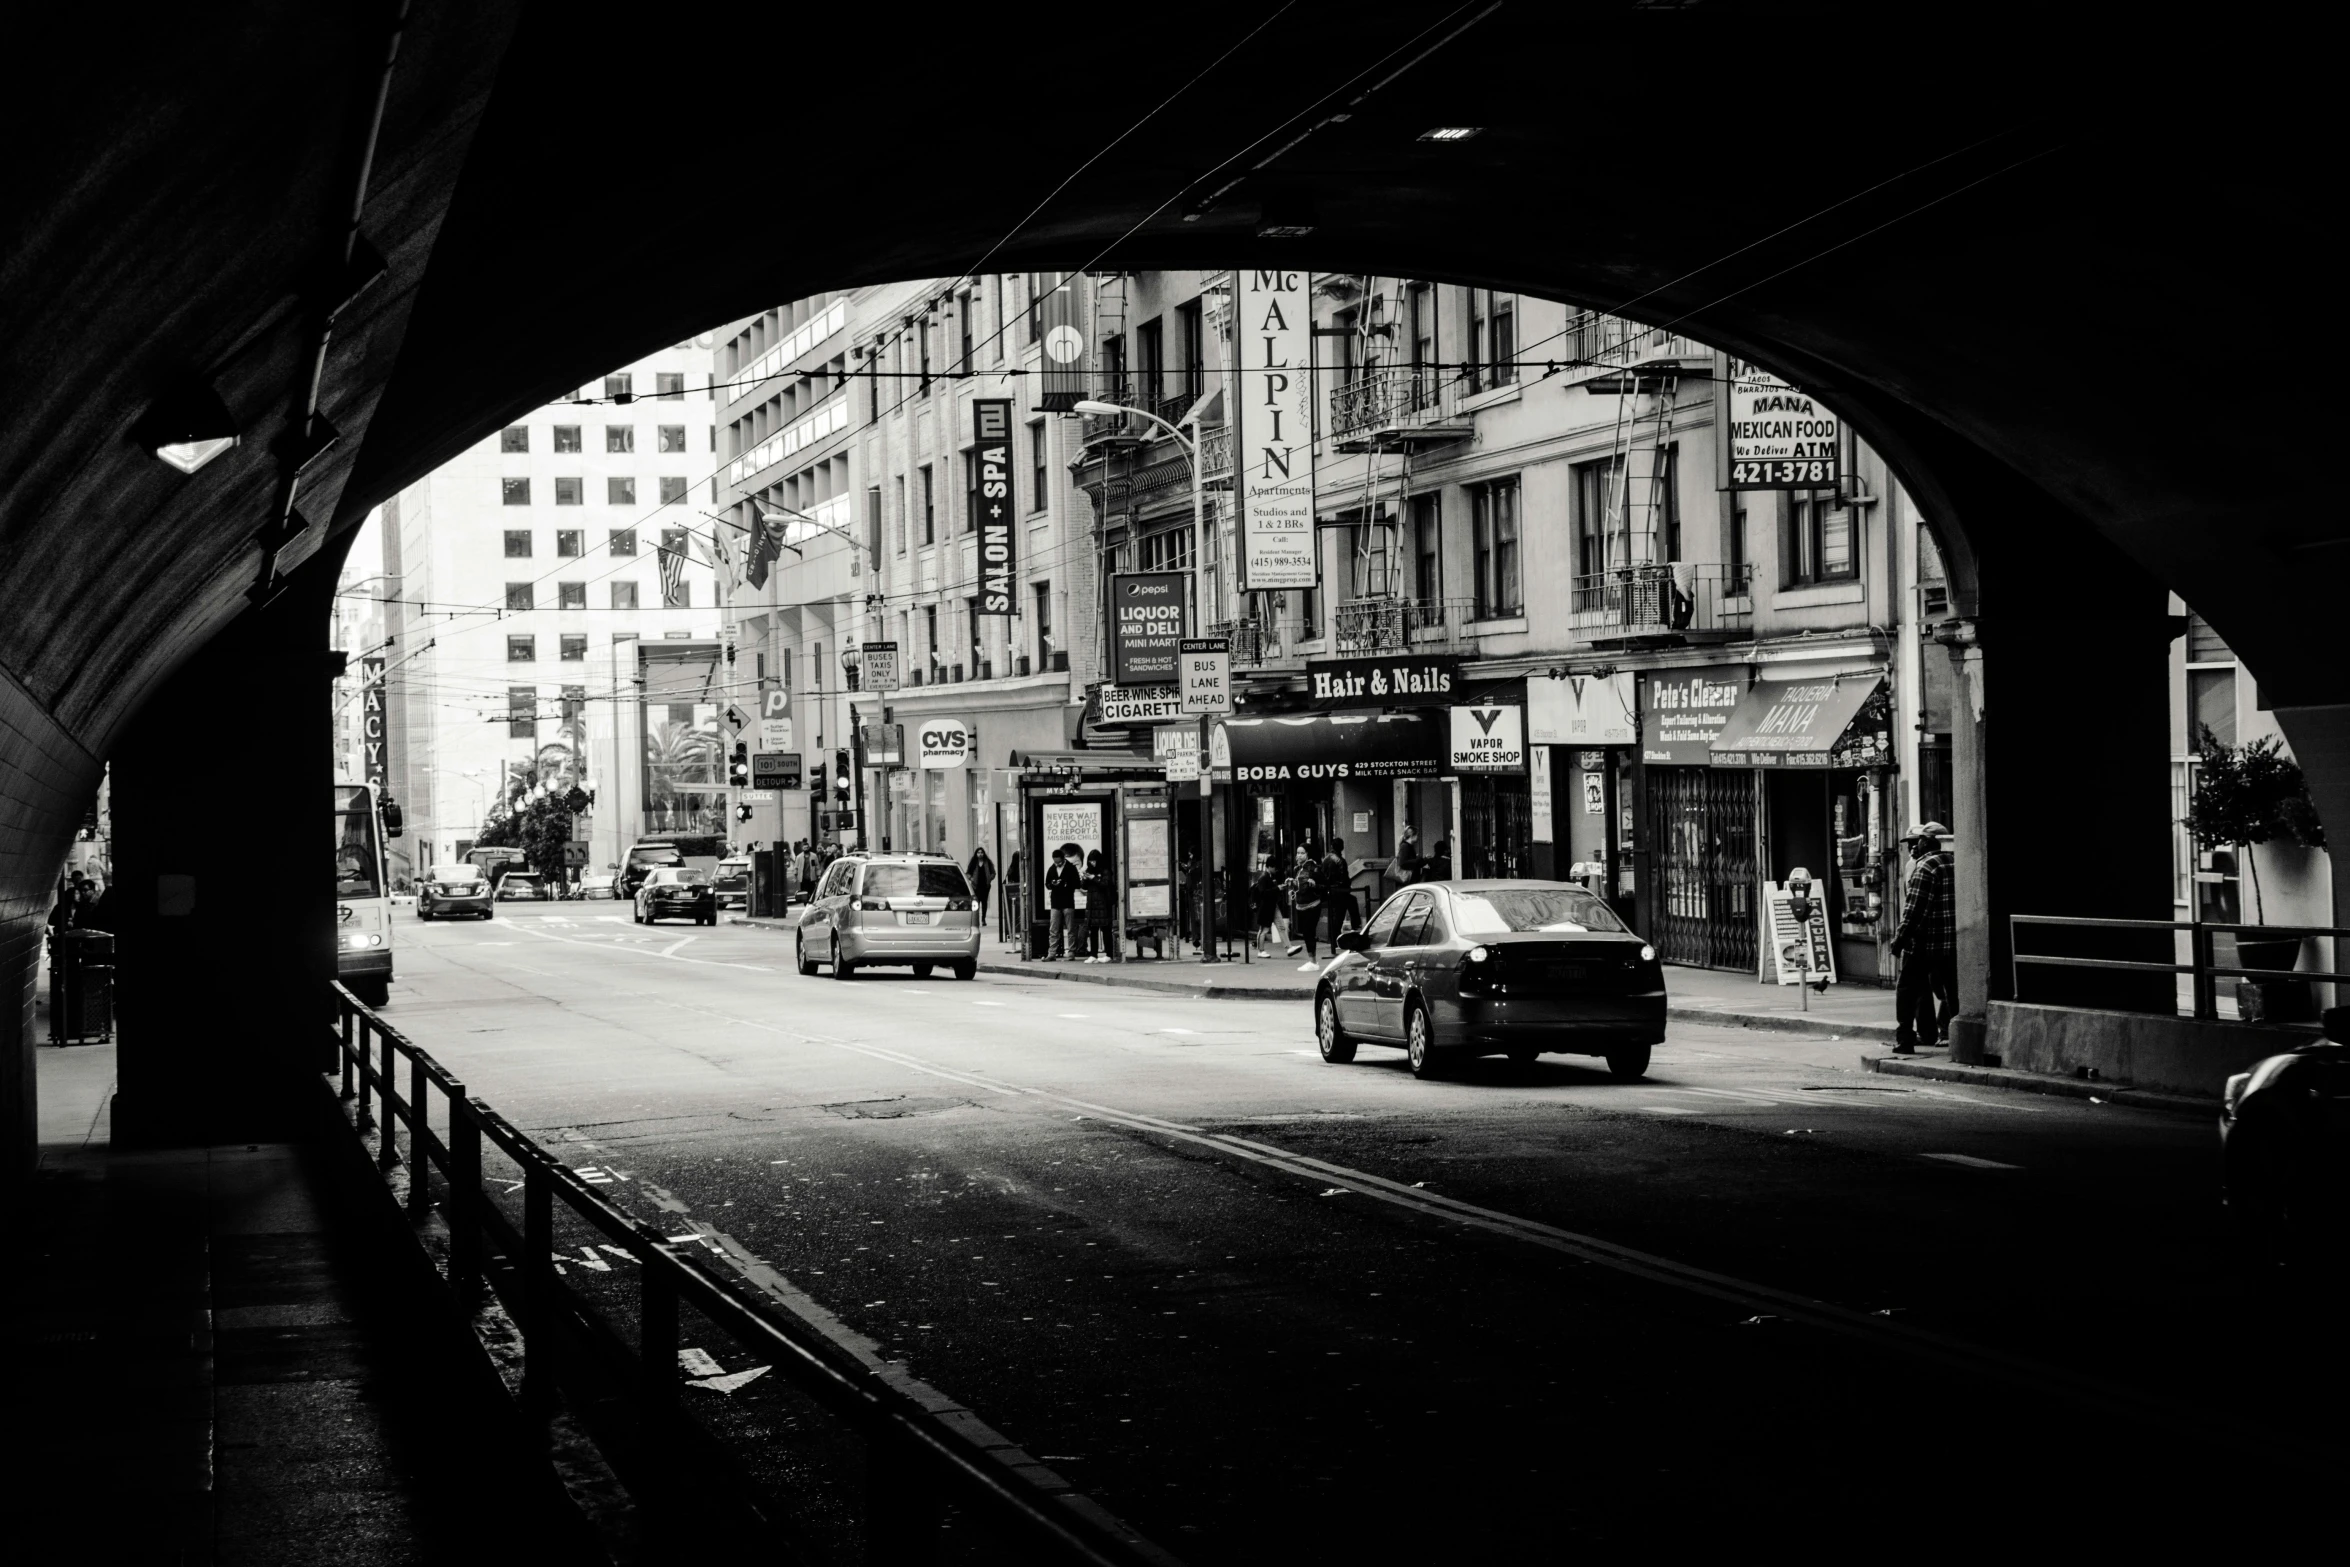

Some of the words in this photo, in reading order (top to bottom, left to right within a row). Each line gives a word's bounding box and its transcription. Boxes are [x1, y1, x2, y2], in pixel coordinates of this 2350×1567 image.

[1752, 395, 1815, 418] MANA
[1731, 420, 1792, 439] MEXICAN
[1796, 420, 1835, 438] FOOD
[1736, 446, 1750, 456] We
[1754, 445, 1788, 455] Deliver
[1793, 442, 1835, 457] ATM
[982, 446, 1007, 499] SPA
[1733, 461, 1834, 483] 421-3781
[1249, 485, 1311, 498] Apartments
[1253, 507, 1288, 516] Studios
[1290, 507, 1307, 516] and
[1258, 520, 1263, 528] 1
[1266, 520, 1274, 528] &
[1276, 520, 1282, 528] 2
[1284, 520, 1304, 528] BRs
[1250, 557, 1273, 568] (415)
[1274, 557, 1311, 566] 989-3534
[985, 525, 1009, 612] SALON
[1141, 584, 1169, 595] pepsi
[1120, 605, 1180, 621] LIQUOR
[1120, 624, 1143, 635] AND
[1146, 621, 1180, 635] DELI
[1125, 639, 1147, 648] MINI
[1149, 638, 1177, 647] MART
[1182, 642, 1207, 650] CENTER
[1209, 642, 1226, 650] LANE
[867, 653, 893, 661] BUSES
[870, 661, 892, 669] TAXIS
[1129, 663, 1173, 672] SANDWICHES
[1194, 661, 1216, 671] BUS
[871, 670, 890, 678] ONLY
[1191, 677, 1219, 688] LANE
[1313, 670, 1365, 699] Hair
[1370, 668, 1388, 695] &
[1392, 667, 1451, 694] Nails
[1188, 694, 1225, 705] AHEAD
[1653, 681, 1689, 709] Pete's
[1780, 685, 1835, 703] TAQUERIA
[1755, 704, 1819, 733] MANA
[922, 730, 966, 748] CVS
[1470, 738, 1503, 749] VAPOR
[923, 749, 965, 757] pharmacy
[1453, 751, 1490, 763] SMOKE
[1492, 751, 1520, 763] SHOP
[760, 761, 773, 769] 101
[777, 760, 798, 768] SOUTH
[1370, 760, 1409, 768] STOCKTON
[1237, 765, 1291, 781] BOBA
[1297, 764, 1349, 778] GUYS
[756, 778, 786, 786] DETOUR
[1046, 812, 1074, 821] NEVER
[1076, 811, 1098, 821] WAIT
[1047, 820, 1059, 828] 24
[1061, 819, 1098, 828] HOURS
[1060, 827, 1090, 835] REPORT
[1809, 899, 1830, 971] TAQUERIA
